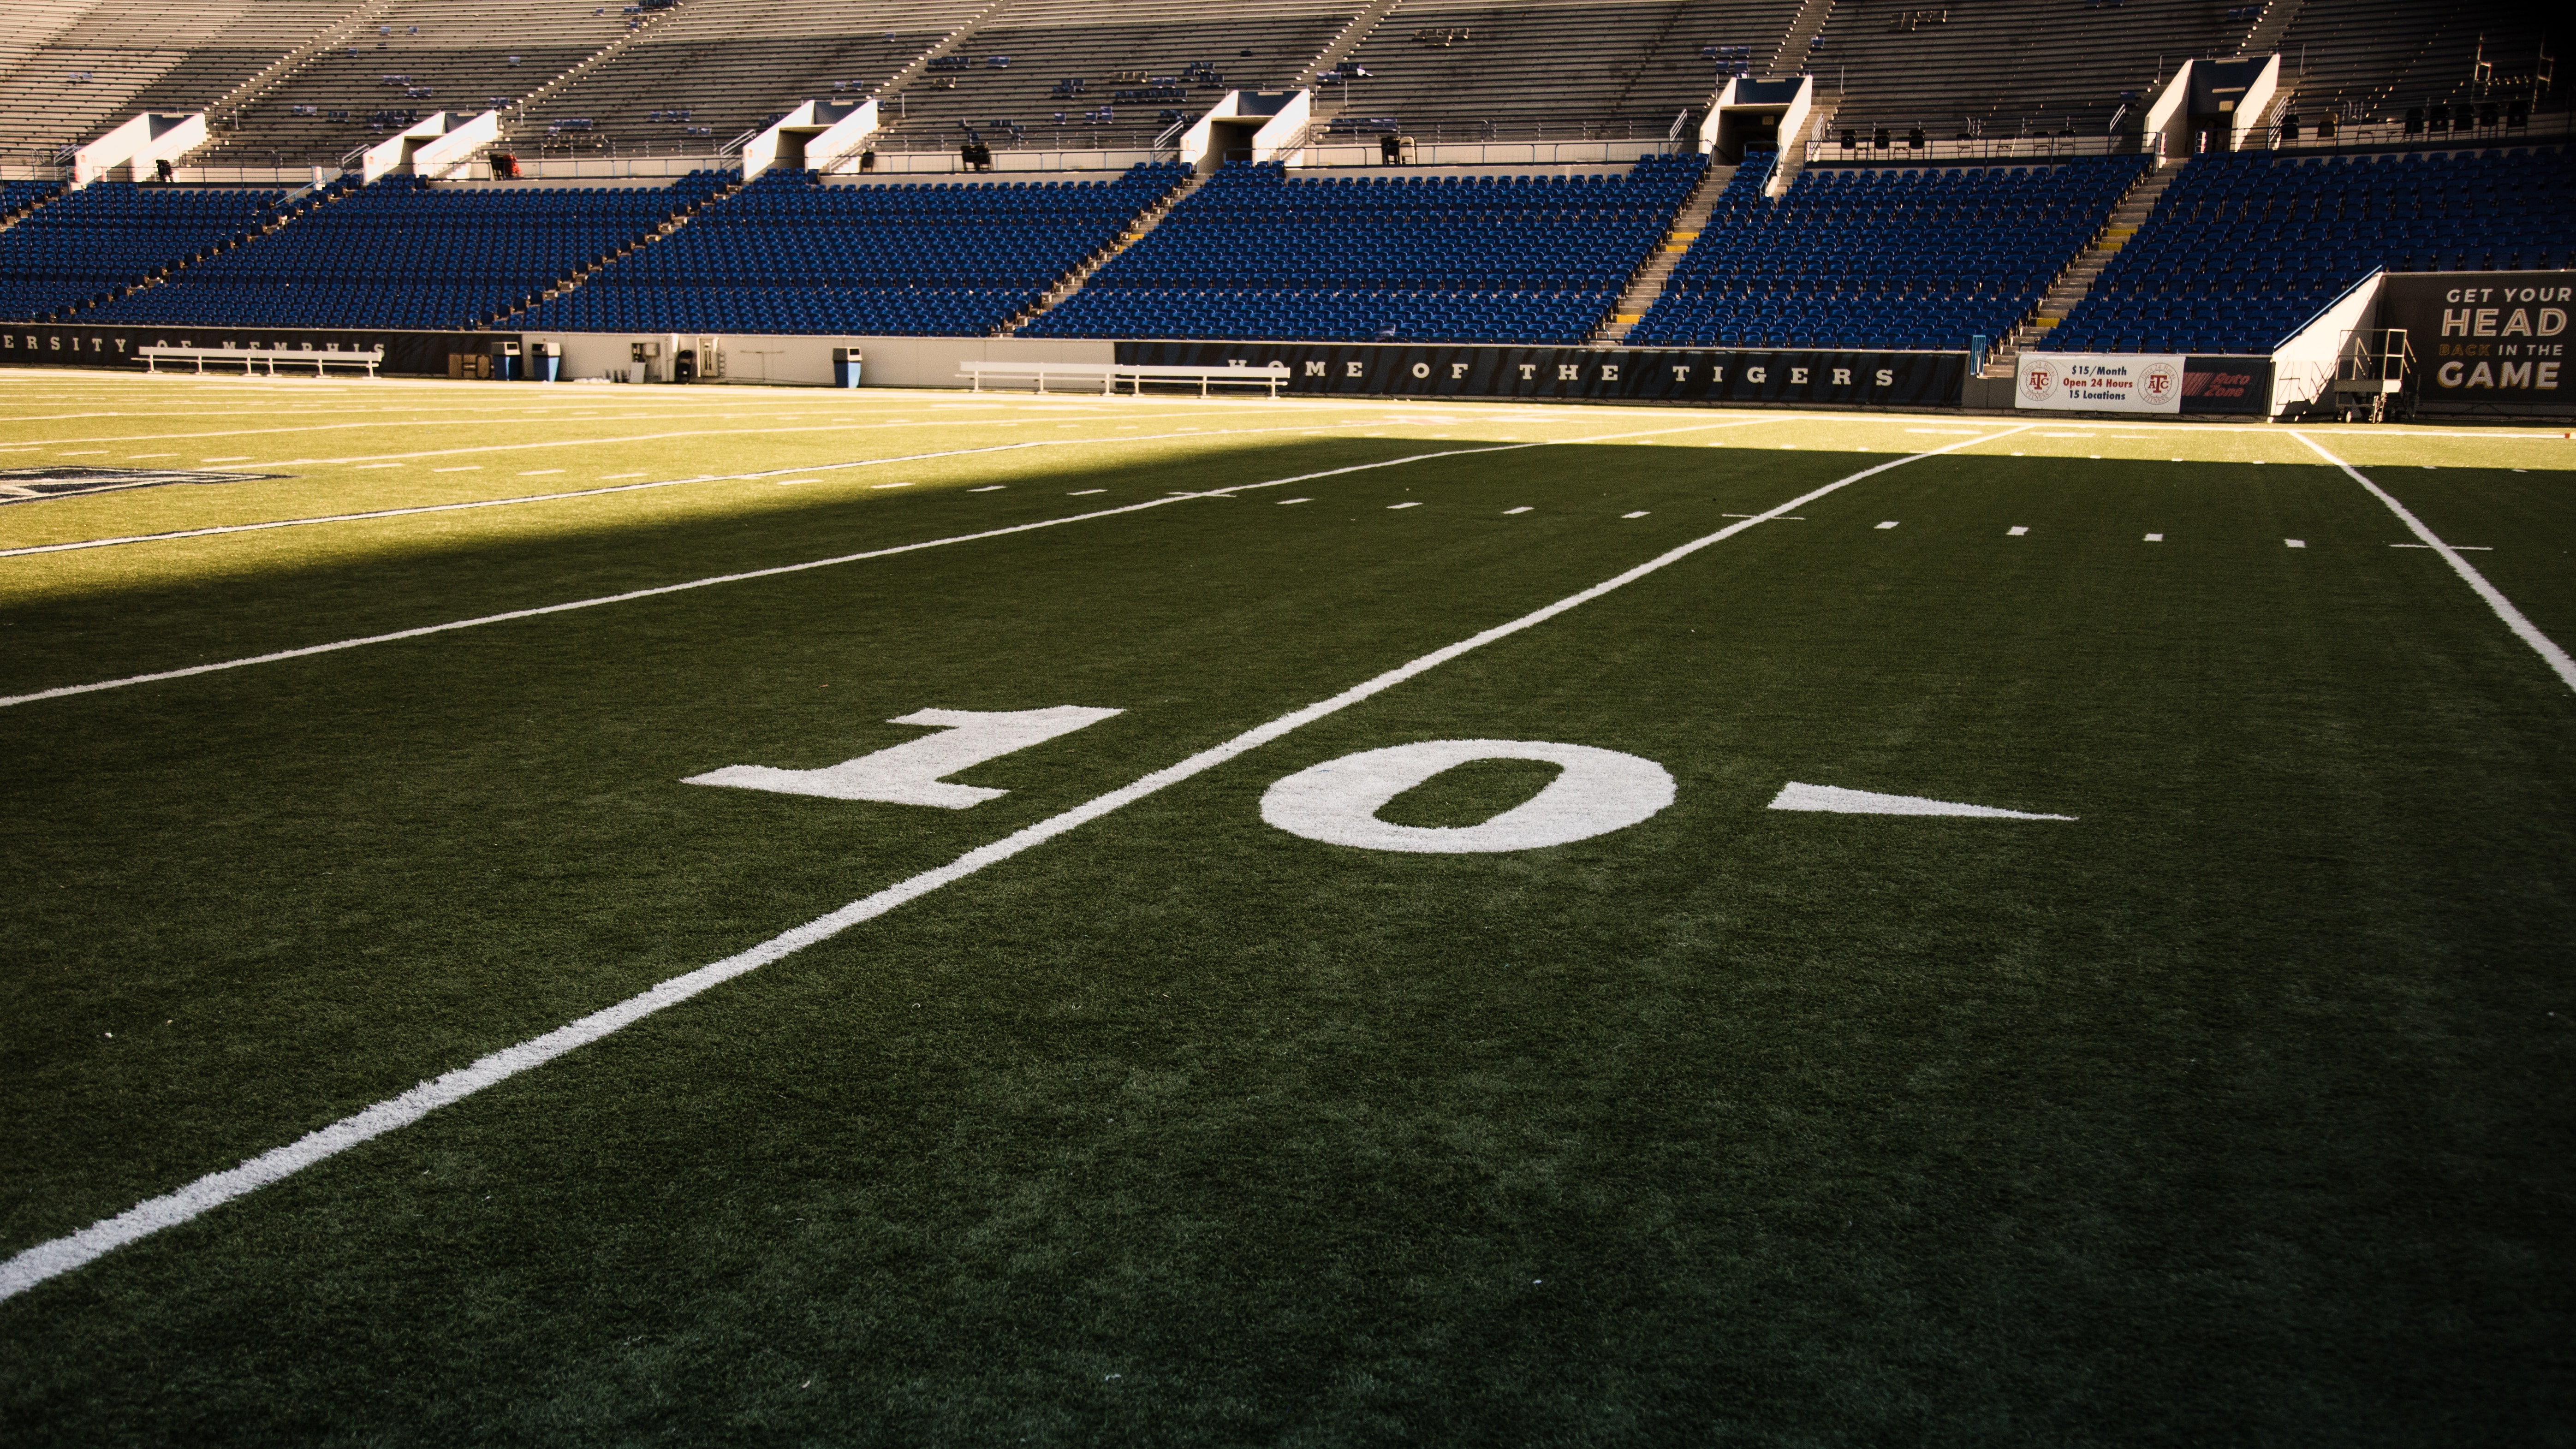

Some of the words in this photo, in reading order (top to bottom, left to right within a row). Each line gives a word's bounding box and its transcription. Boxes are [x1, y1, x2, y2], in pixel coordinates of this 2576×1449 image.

[2446, 289, 2493, 303] GET
[2505, 287, 2572, 302] YOUR
[2441, 308, 2567, 337] HEAD
[4, 335, 126, 352] ERSITY
[2439, 344, 2491, 356] BACK
[2498, 344, 2517, 356] IN
[2527, 344, 2564, 356] THE
[1412, 362, 1468, 379] OF
[1519, 364, 1618, 381] THE
[1672, 366, 1893, 386] TIGERS
[2072, 365, 2127, 377] $15/Month
[2437, 361, 2561, 389] GAME
[2063, 378, 2087, 389] Open
[2091, 378, 2102, 387] 24
[2106, 379, 2133, 388] Hours
[2212, 372, 2251, 385] Auto
[2070, 390, 2080, 398] 15
[2083, 390, 2125, 400] Locations
[2203, 385, 2244, 397] Zone
